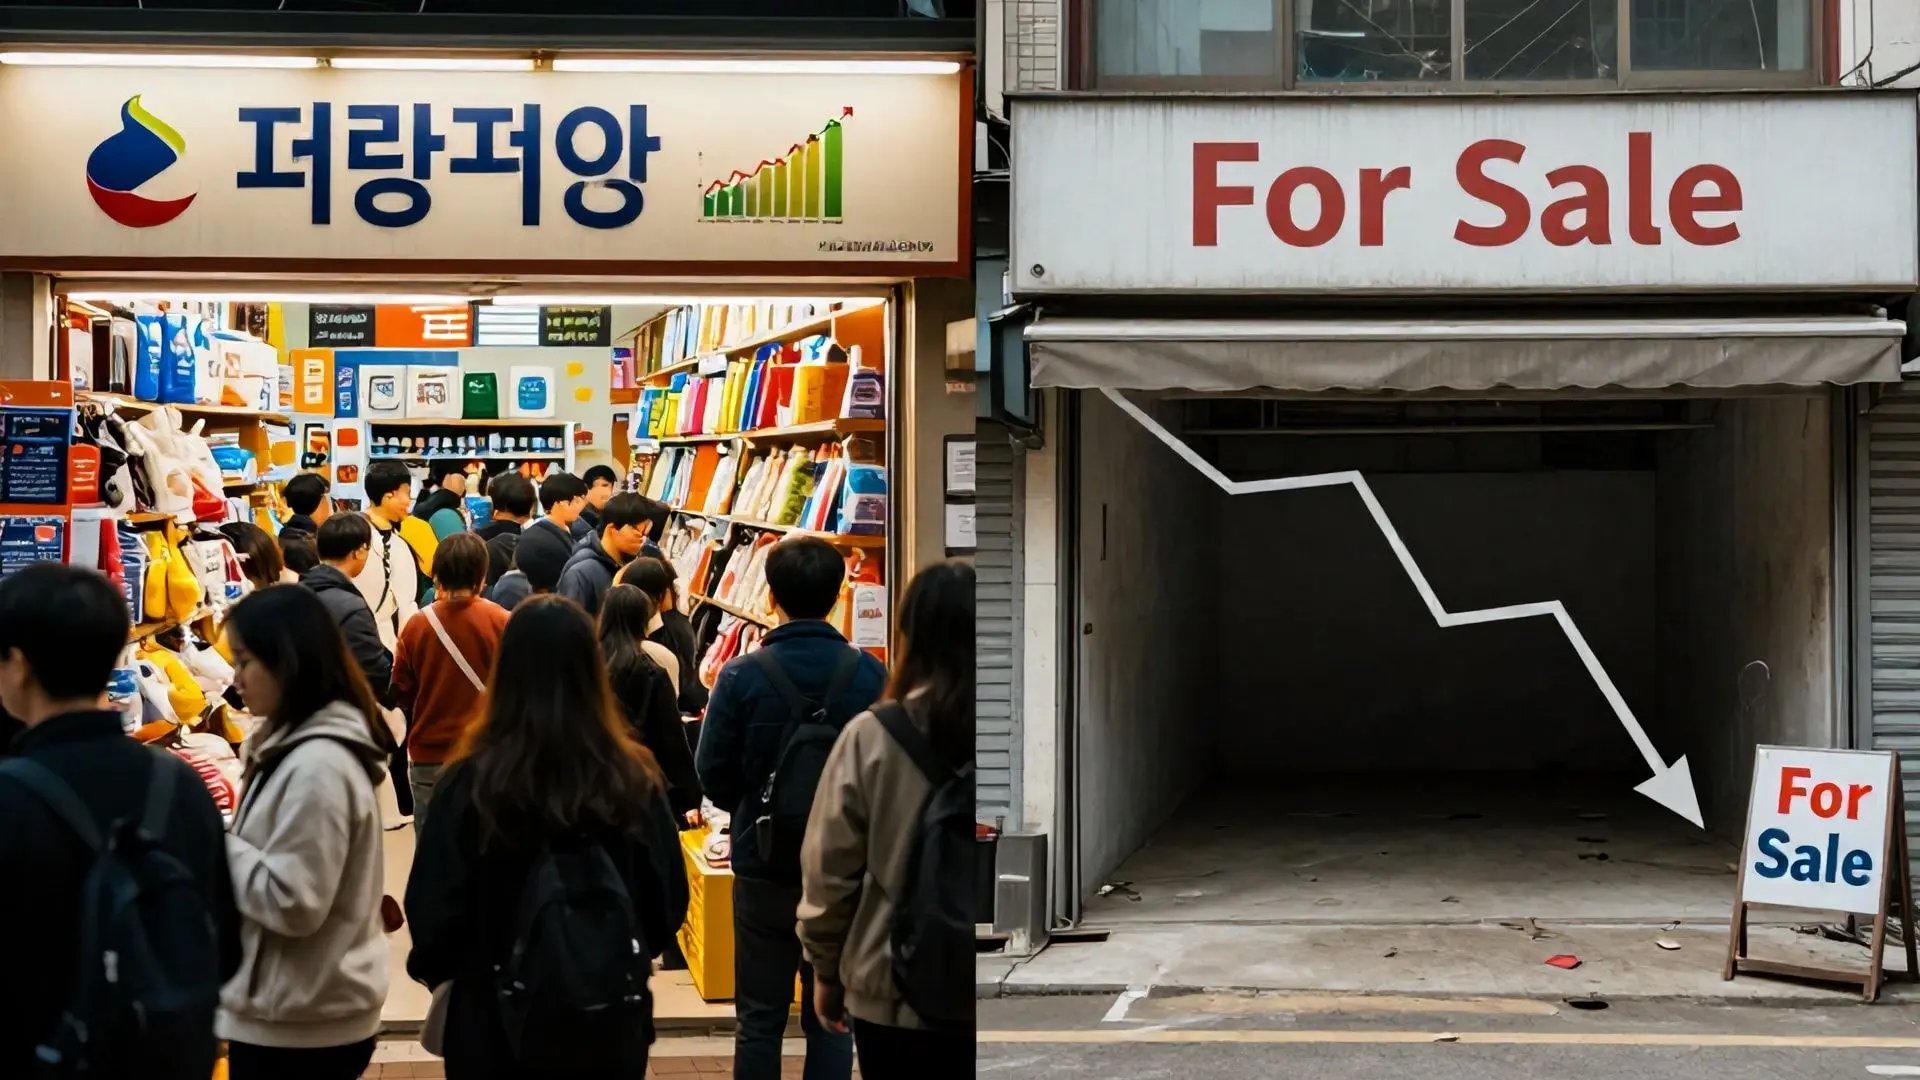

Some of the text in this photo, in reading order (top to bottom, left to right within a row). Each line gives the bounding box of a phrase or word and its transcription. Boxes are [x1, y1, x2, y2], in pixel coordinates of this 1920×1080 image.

[1192, 131, 1743, 248] For Sale
[1777, 766, 1873, 820] For
[1754, 827, 1873, 887] Sale
